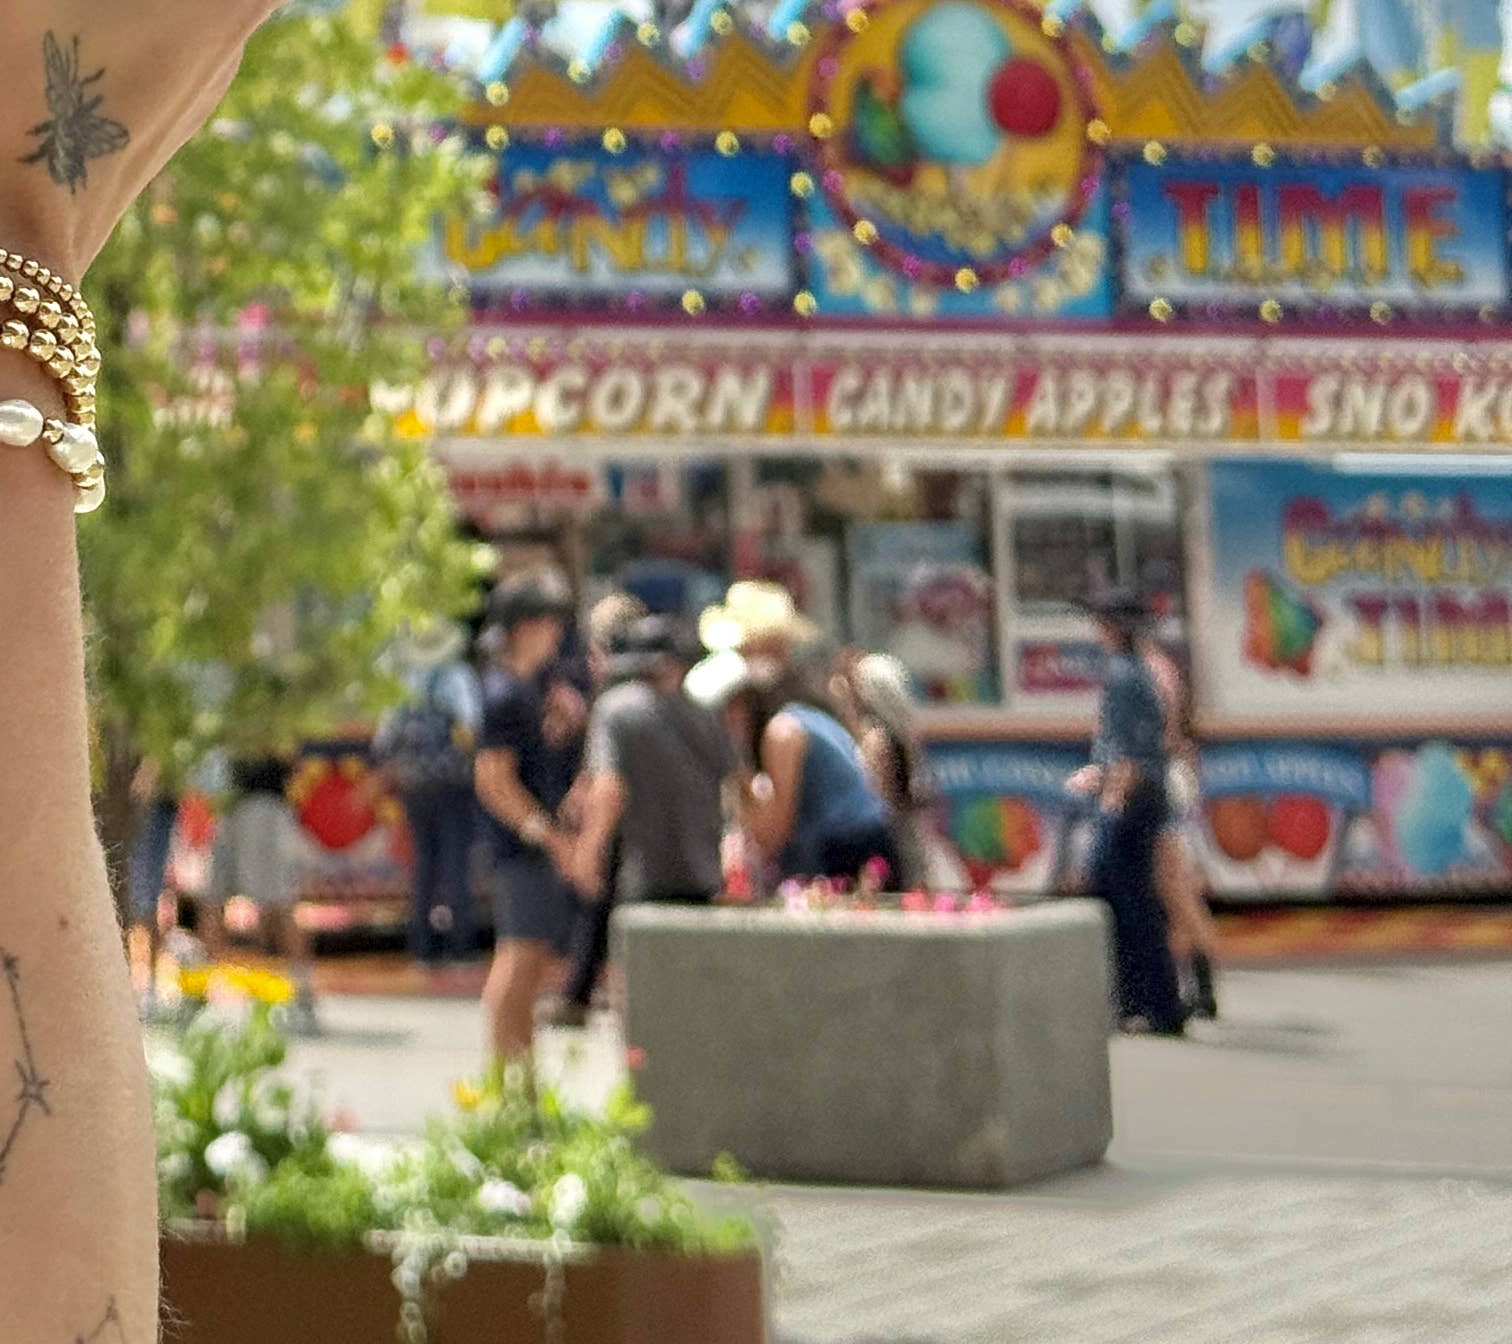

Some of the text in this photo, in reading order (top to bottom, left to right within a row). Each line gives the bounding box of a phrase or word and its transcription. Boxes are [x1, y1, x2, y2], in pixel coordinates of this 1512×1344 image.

[1162, 180, 1464, 286] TIME
[828, 362, 1234, 434] CANDY APPLES
[1303, 370, 1432, 437] SNO
